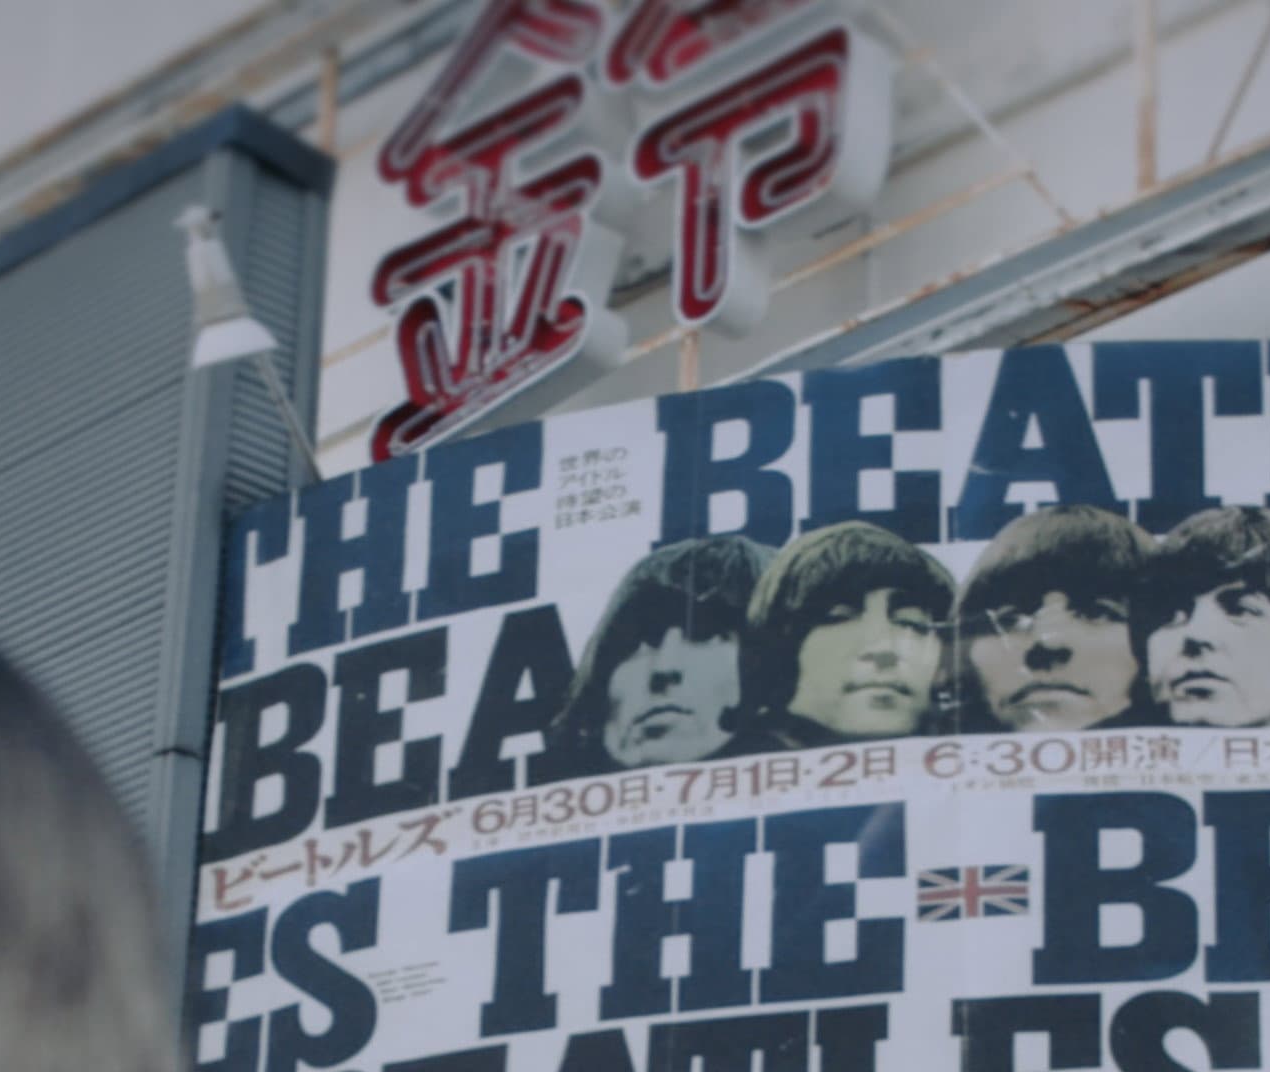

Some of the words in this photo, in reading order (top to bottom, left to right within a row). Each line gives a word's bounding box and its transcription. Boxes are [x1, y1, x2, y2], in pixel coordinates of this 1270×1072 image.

[222, 420, 545, 682] THE
[211, 808, 461, 912] ビートルズ
[449, 801, 907, 1038] THE
